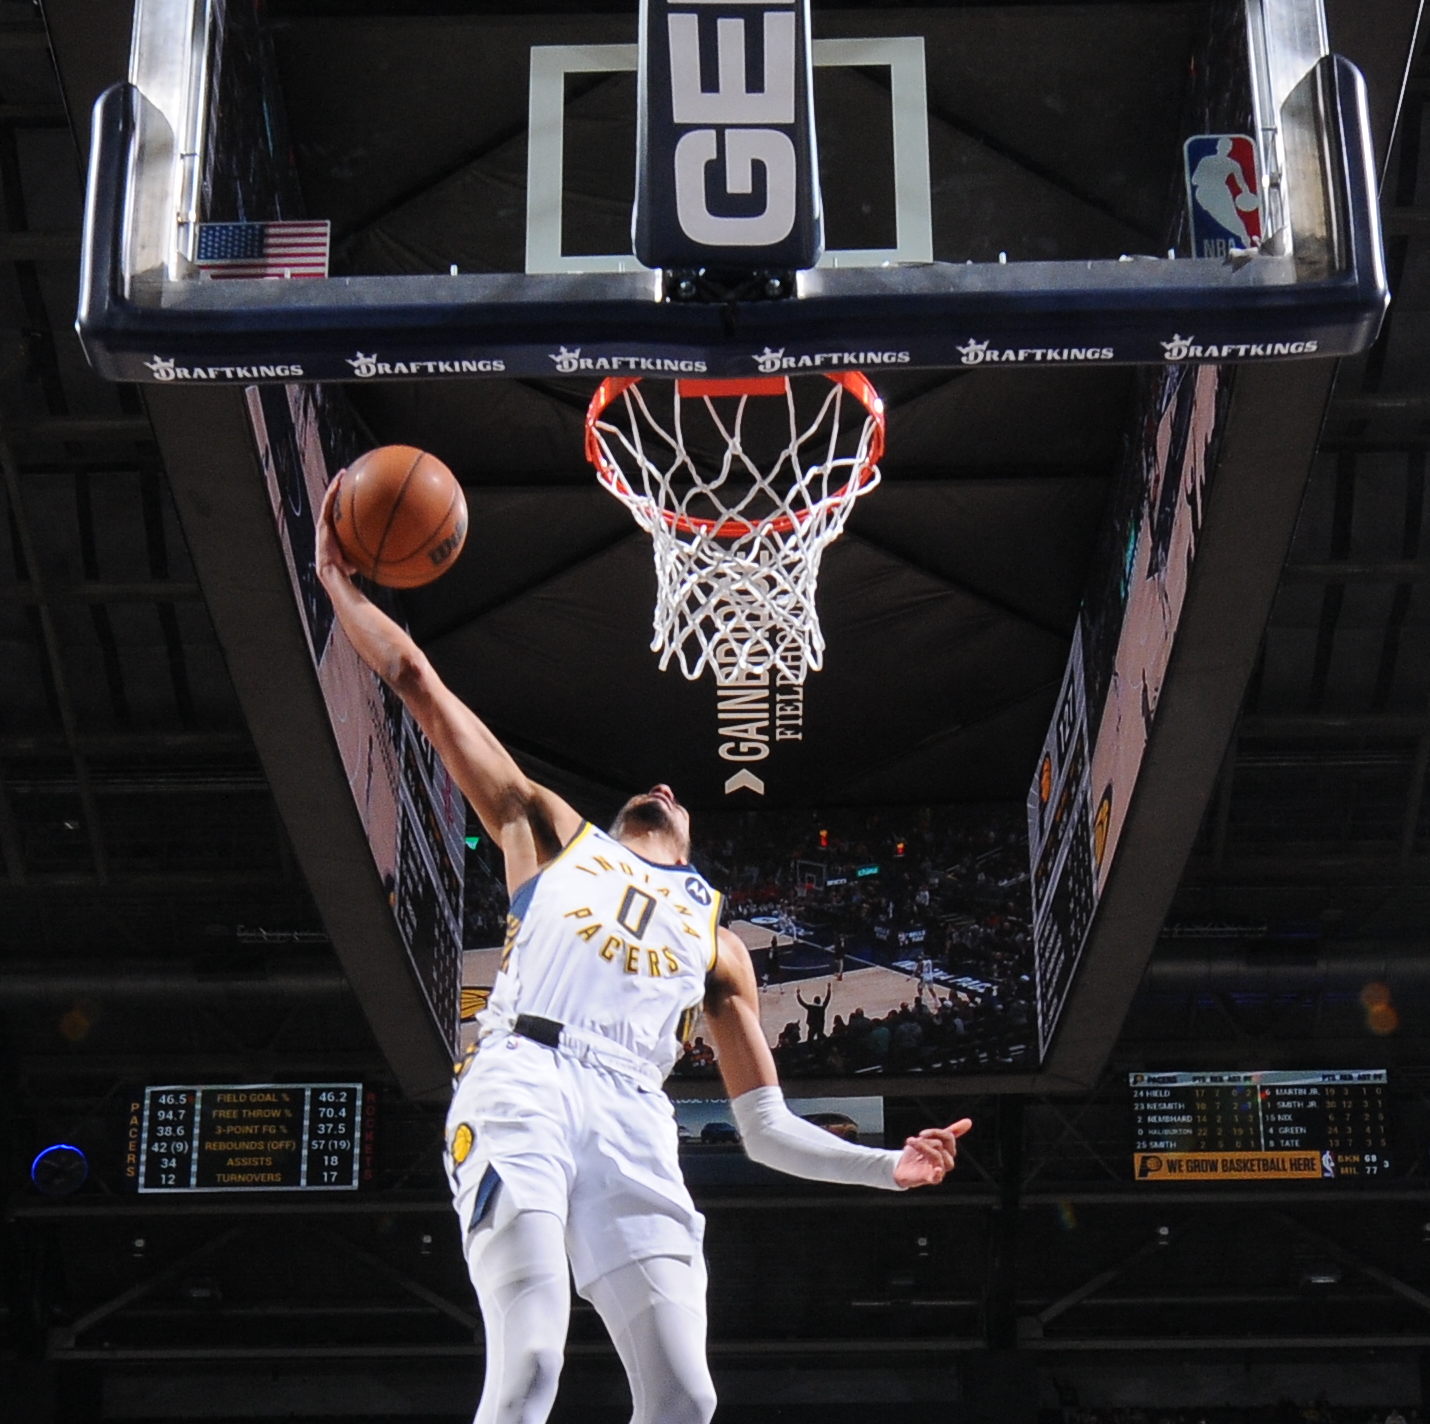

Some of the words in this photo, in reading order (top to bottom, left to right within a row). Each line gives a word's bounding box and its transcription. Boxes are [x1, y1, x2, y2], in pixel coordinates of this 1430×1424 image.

[667, 0, 797, 246] GE
[958, 340, 1114, 365] DRAFTKINGS
[1163, 336, 1317, 361] DRAFTKINGS
[348, 354, 505, 377] DRAFTKINGS
[550, 348, 708, 373] DRAFTKINGS
[755, 348, 911, 373] DRAFTKINGS
[146, 357, 304, 381] DRAFTKINGS
[575, 855, 700, 939] INDIANA
[616, 884, 657, 941] 0
[564, 907, 679, 977] PACERS
[158, 1094, 187, 1105] 46.5
[216, 1094, 246, 1103] FIELD
[249, 1094, 278, 1103] GOAL
[318, 1091, 347, 1103] 46.2
[157, 1110, 186, 1121] 94.7
[212, 1109, 238, 1118] FREE
[242, 1109, 281, 1118] THROW
[317, 1107, 347, 1118] 70.4
[156, 1126, 185, 1137] 38.6
[215, 1125, 259, 1134] 3-POINT
[317, 1123, 346, 1134] 37.5
[151, 1142, 168, 1153] 42
[171, 1141, 189, 1153] (9)
[205, 1141, 264, 1150] REBOUNDS
[267, 1140, 296, 1151] (OFF)
[311, 1140, 325, 1150] 57
[328, 1139, 351, 1151] (19)
[160, 1158, 177, 1169] 34
[227, 1157, 273, 1166] ASSISTS
[323, 1156, 339, 1167] 18
[1166, 1159, 1184, 1173] WE
[1186, 1159, 1218, 1173] GROW
[1221, 1158, 1288, 1173] BASKETBALL
[1290, 1158, 1316, 1172] HERE
[1365, 1166, 1378, 1175] 77
[160, 1174, 176, 1185] 12
[216, 1173, 281, 1183] TURNOVERS
[322, 1172, 338, 1183] 17
